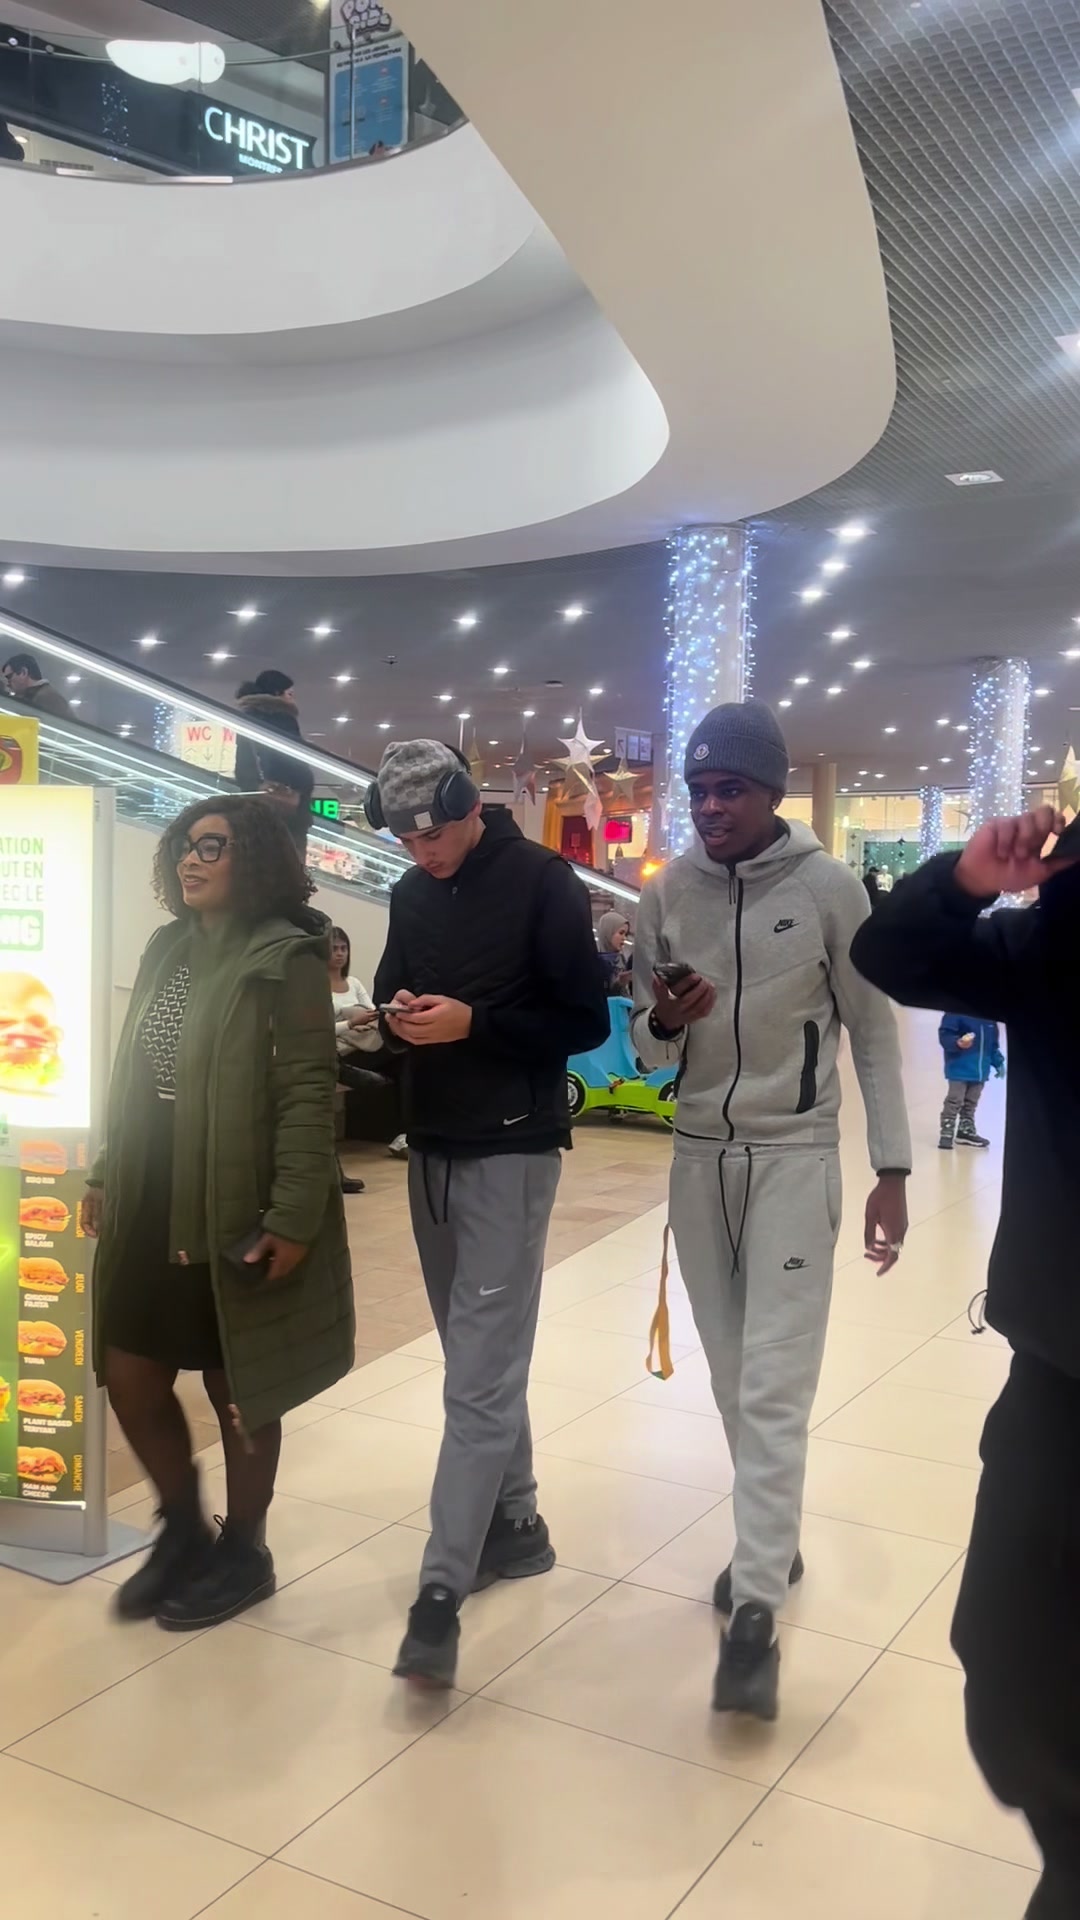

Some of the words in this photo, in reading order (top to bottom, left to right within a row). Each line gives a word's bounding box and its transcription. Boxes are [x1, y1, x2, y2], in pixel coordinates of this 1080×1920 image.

[204, 106, 310, 170] CHRIST
[187, 726, 212, 741] WC
[24, 861, 44, 878] EN
[26, 885, 44, 902] LE
[75, 1272, 85, 1293] JEUDI
[74, 1329, 84, 1366] VENDREDI
[74, 1395, 83, 1423] SAMEDI
[73, 1455, 82, 1492] DIMANCHE
